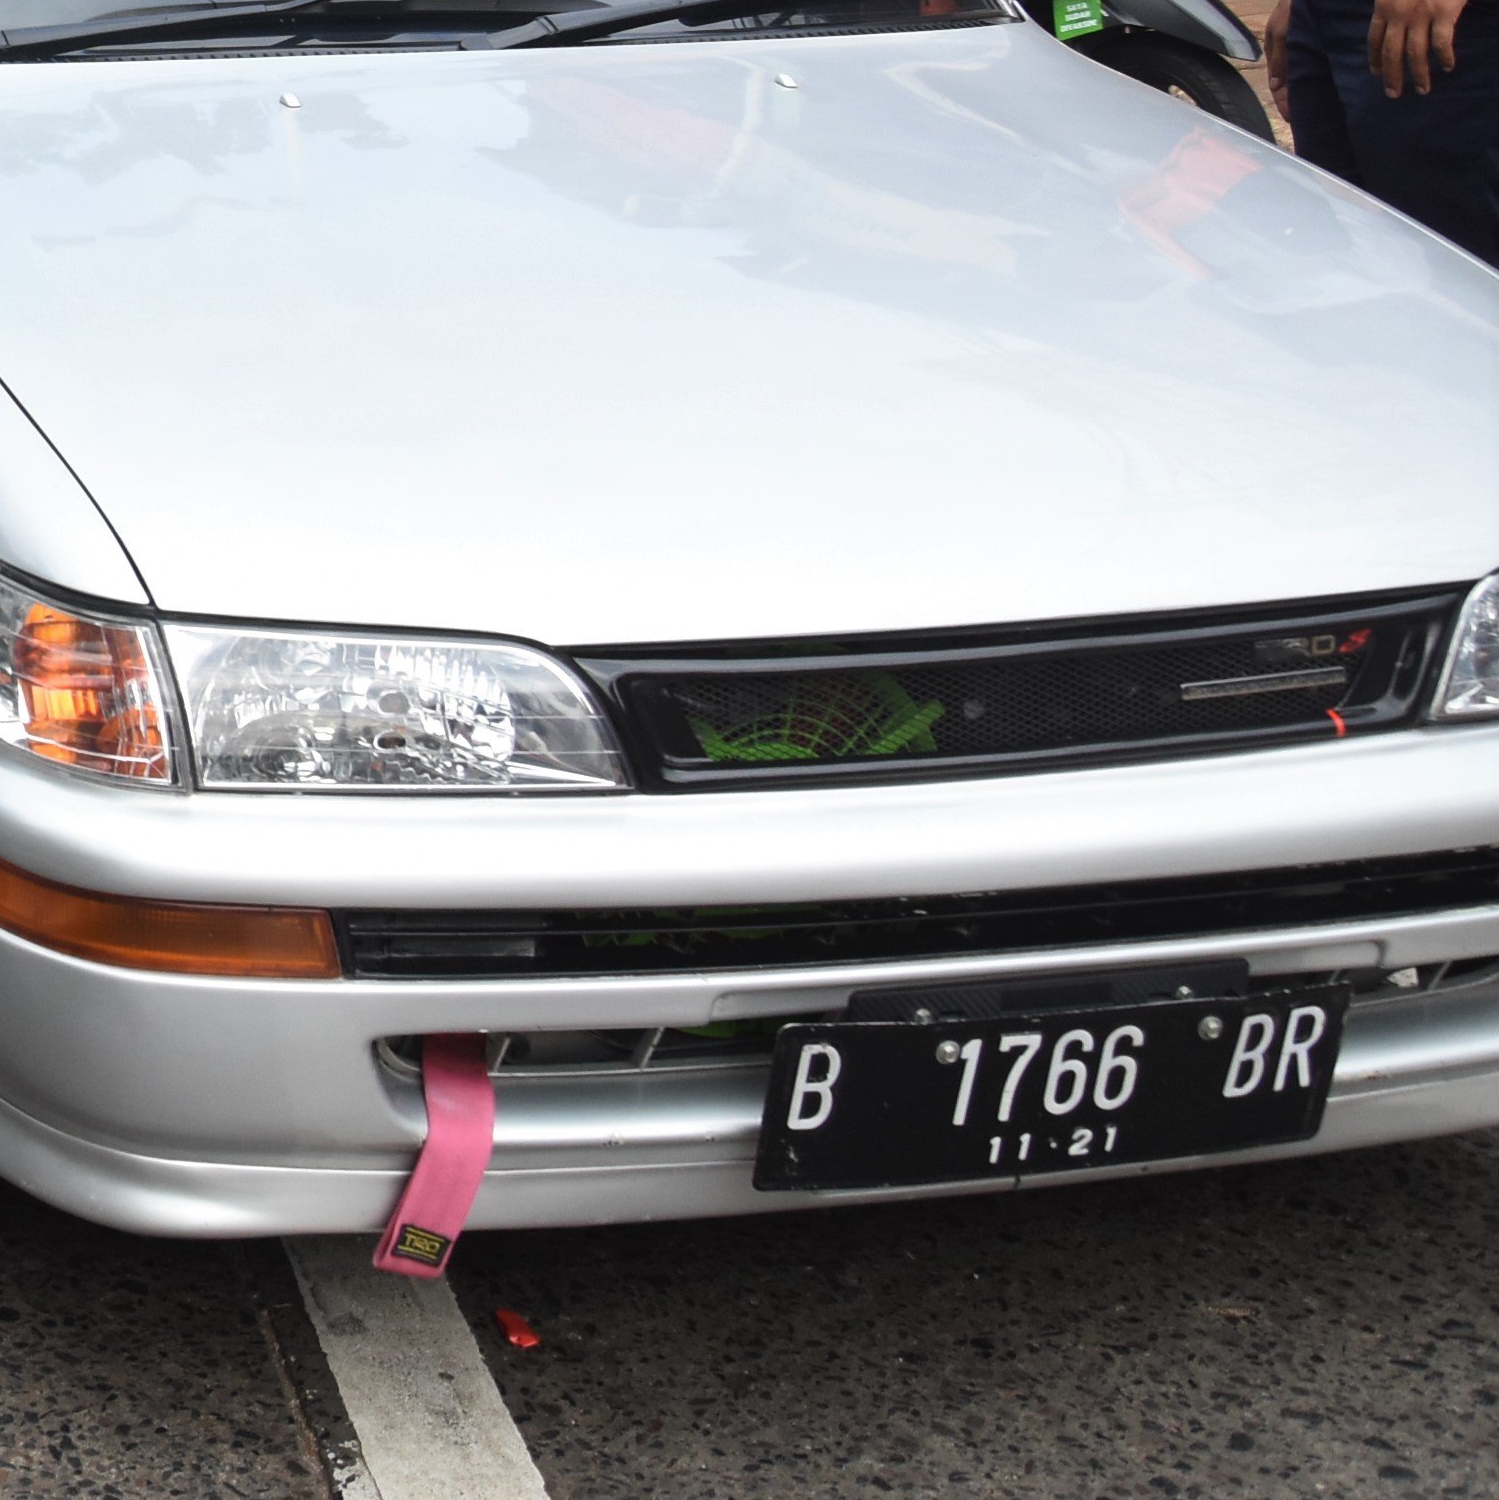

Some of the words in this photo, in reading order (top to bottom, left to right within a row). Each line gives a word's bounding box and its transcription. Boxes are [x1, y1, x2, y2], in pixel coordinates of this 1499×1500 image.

[786, 1044, 842, 1130] B
[952, 1025, 1146, 1127] 1766
[1222, 1005, 1326, 1099] BR
[405, 1232, 441, 1254] TRD
